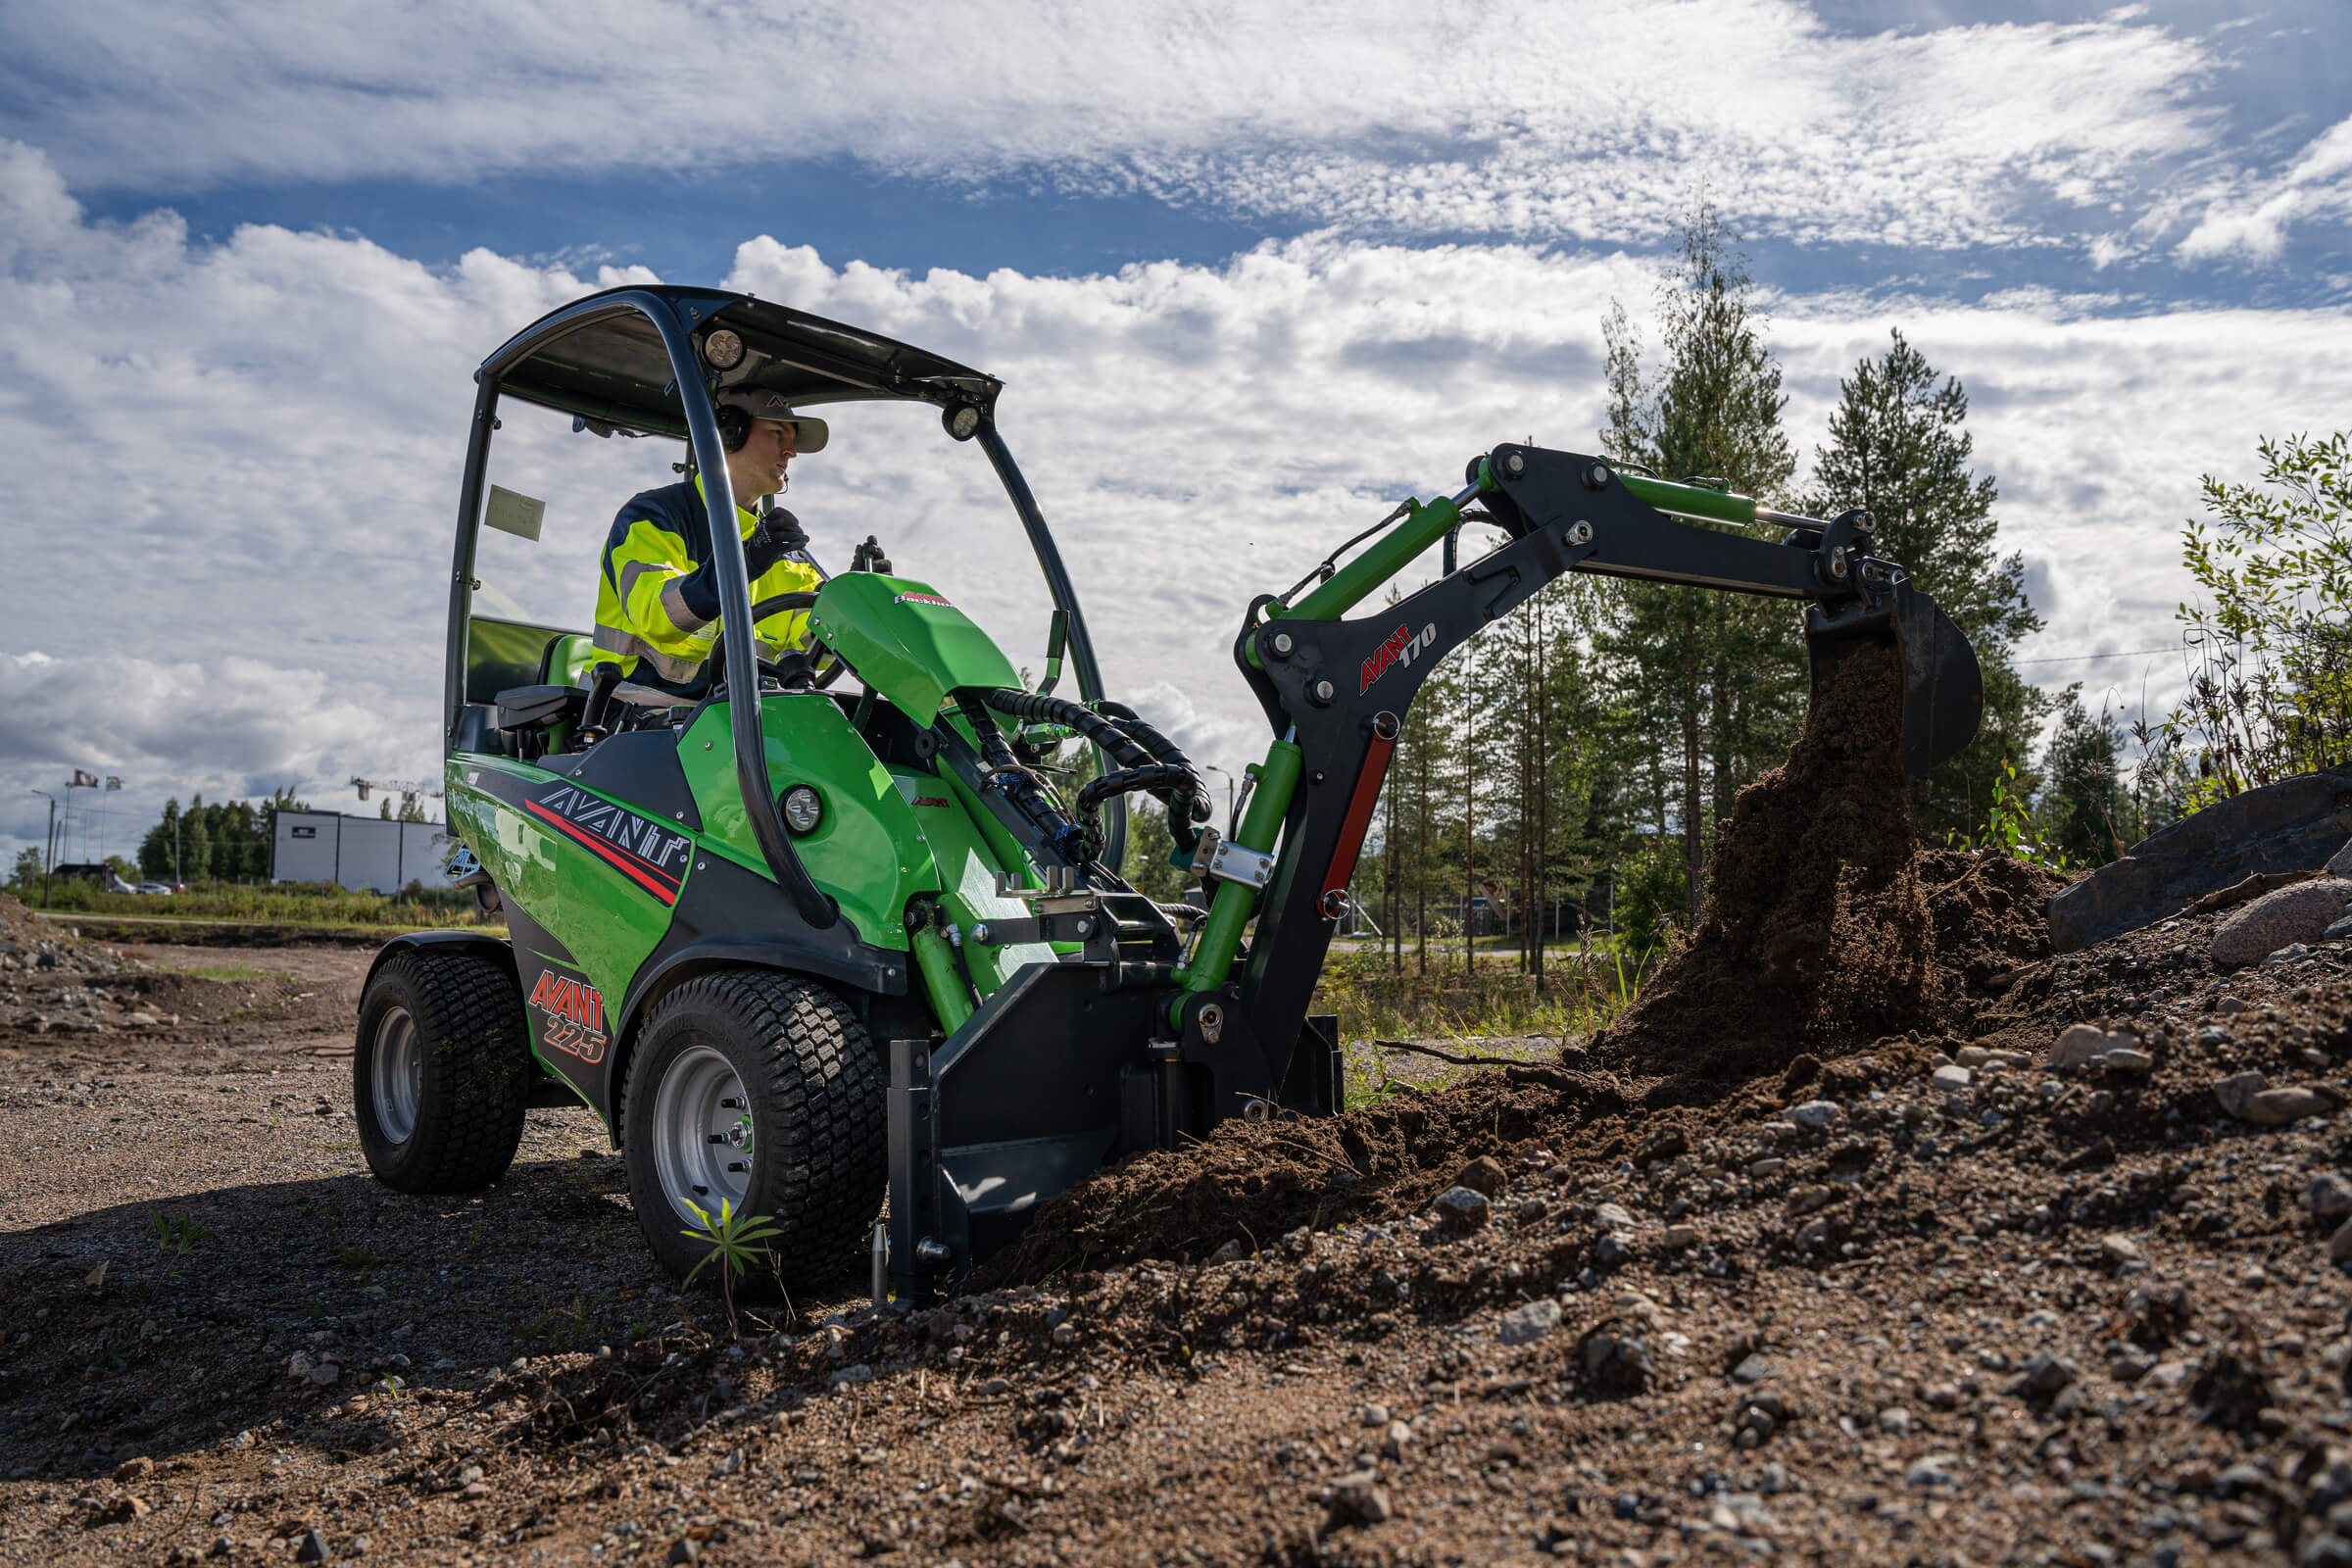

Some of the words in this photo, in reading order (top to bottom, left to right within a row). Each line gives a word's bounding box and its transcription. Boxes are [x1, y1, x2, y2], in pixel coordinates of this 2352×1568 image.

[1359, 622, 1412, 697] AVANT
[1398, 622, 1437, 668] 170
[539, 786, 690, 867] AVANT
[528, 968, 604, 1035] AVANT
[544, 1015, 608, 1064] 225
